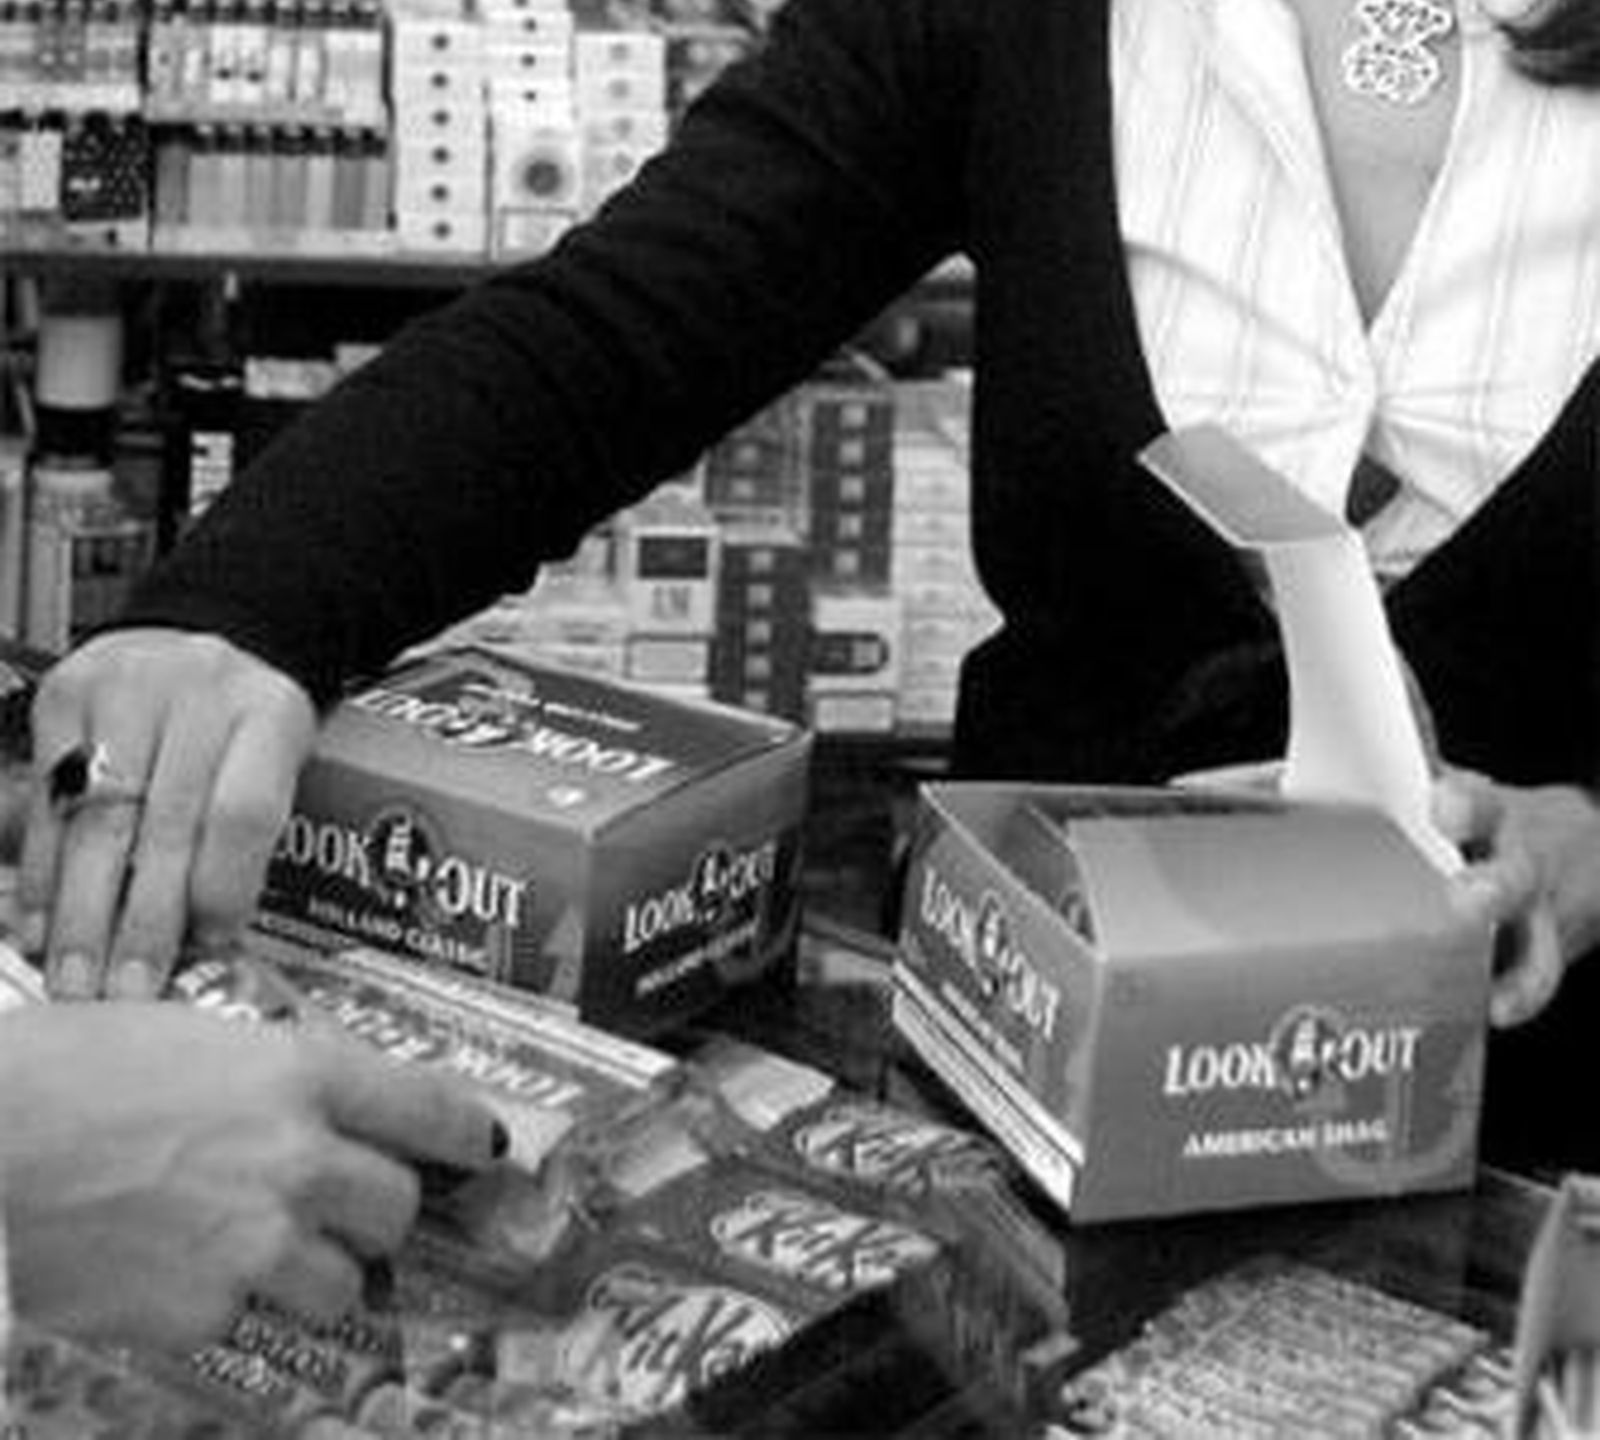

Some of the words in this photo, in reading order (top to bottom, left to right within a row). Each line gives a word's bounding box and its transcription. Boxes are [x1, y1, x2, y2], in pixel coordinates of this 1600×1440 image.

[436, 856, 530, 930] OUT
[1162, 1043, 1278, 1096] LOOK
[1336, 1026, 1424, 1080] OUT
